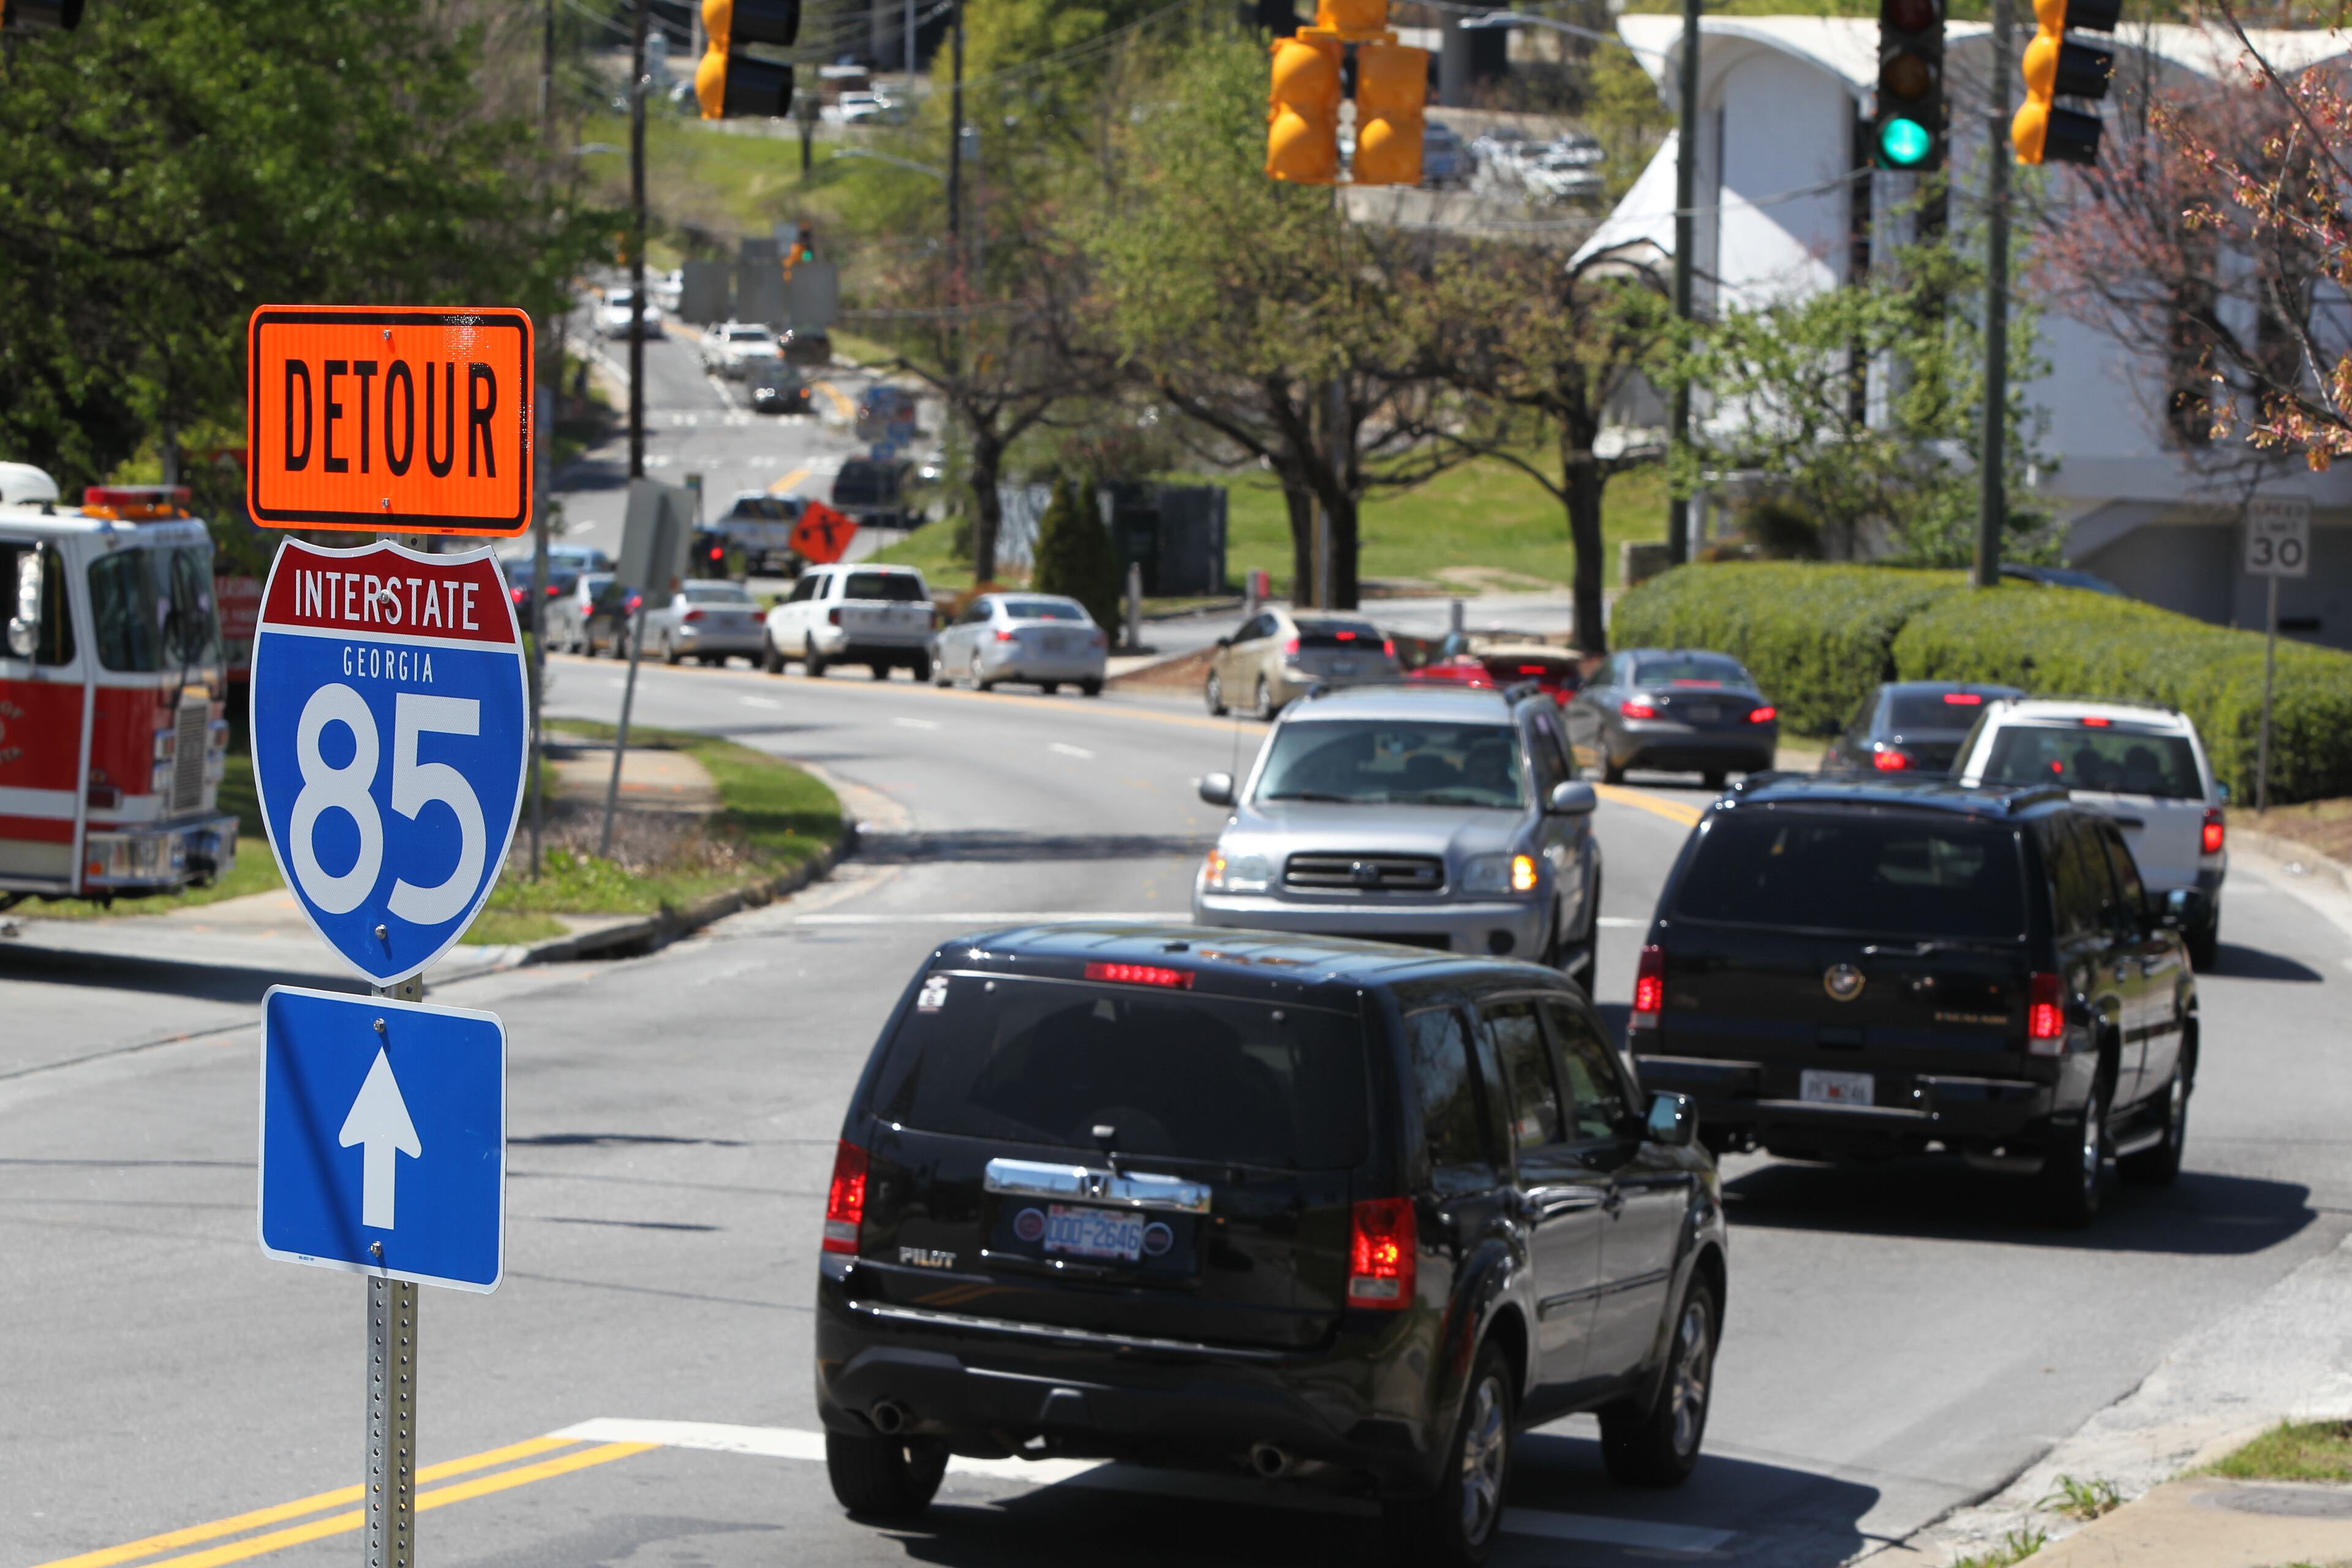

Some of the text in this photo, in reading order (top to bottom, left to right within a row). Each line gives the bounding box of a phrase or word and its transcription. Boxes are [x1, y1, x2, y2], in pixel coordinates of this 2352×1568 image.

[285, 359, 497, 478] DETOUR
[2252, 536, 2304, 568] 30
[295, 568, 480, 631] INTERSTATE
[344, 646, 433, 684] GEORGIA
[290, 682, 487, 925] 85
[899, 1246, 957, 1269] PILOT
